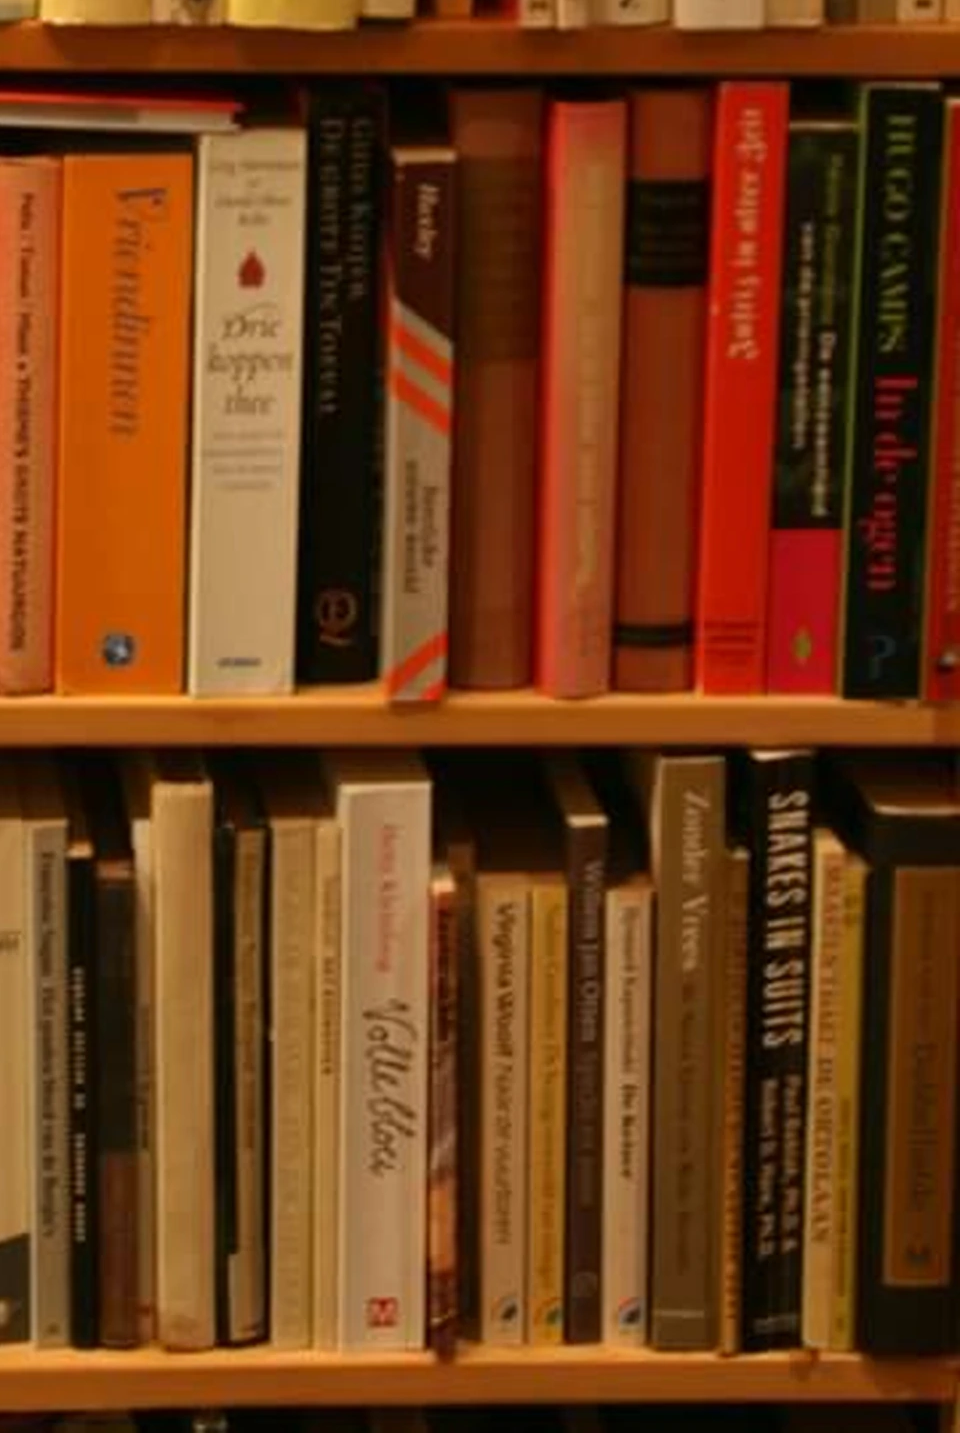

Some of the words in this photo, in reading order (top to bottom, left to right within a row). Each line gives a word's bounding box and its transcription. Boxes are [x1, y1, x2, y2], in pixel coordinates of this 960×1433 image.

[885, 113, 916, 221] HUGO
[413, 183, 439, 260] Huxley
[108, 188, 166, 436] Vriendinnen
[877, 234, 909, 353] CAMPS
[683, 791, 708, 882] Zonder
[767, 792, 810, 904] SNAKES
[492, 904, 516, 986] Virginia
[681, 896, 706, 972] Vrees
[765, 916, 804, 950] IN
[761, 962, 804, 1048] SUITS
